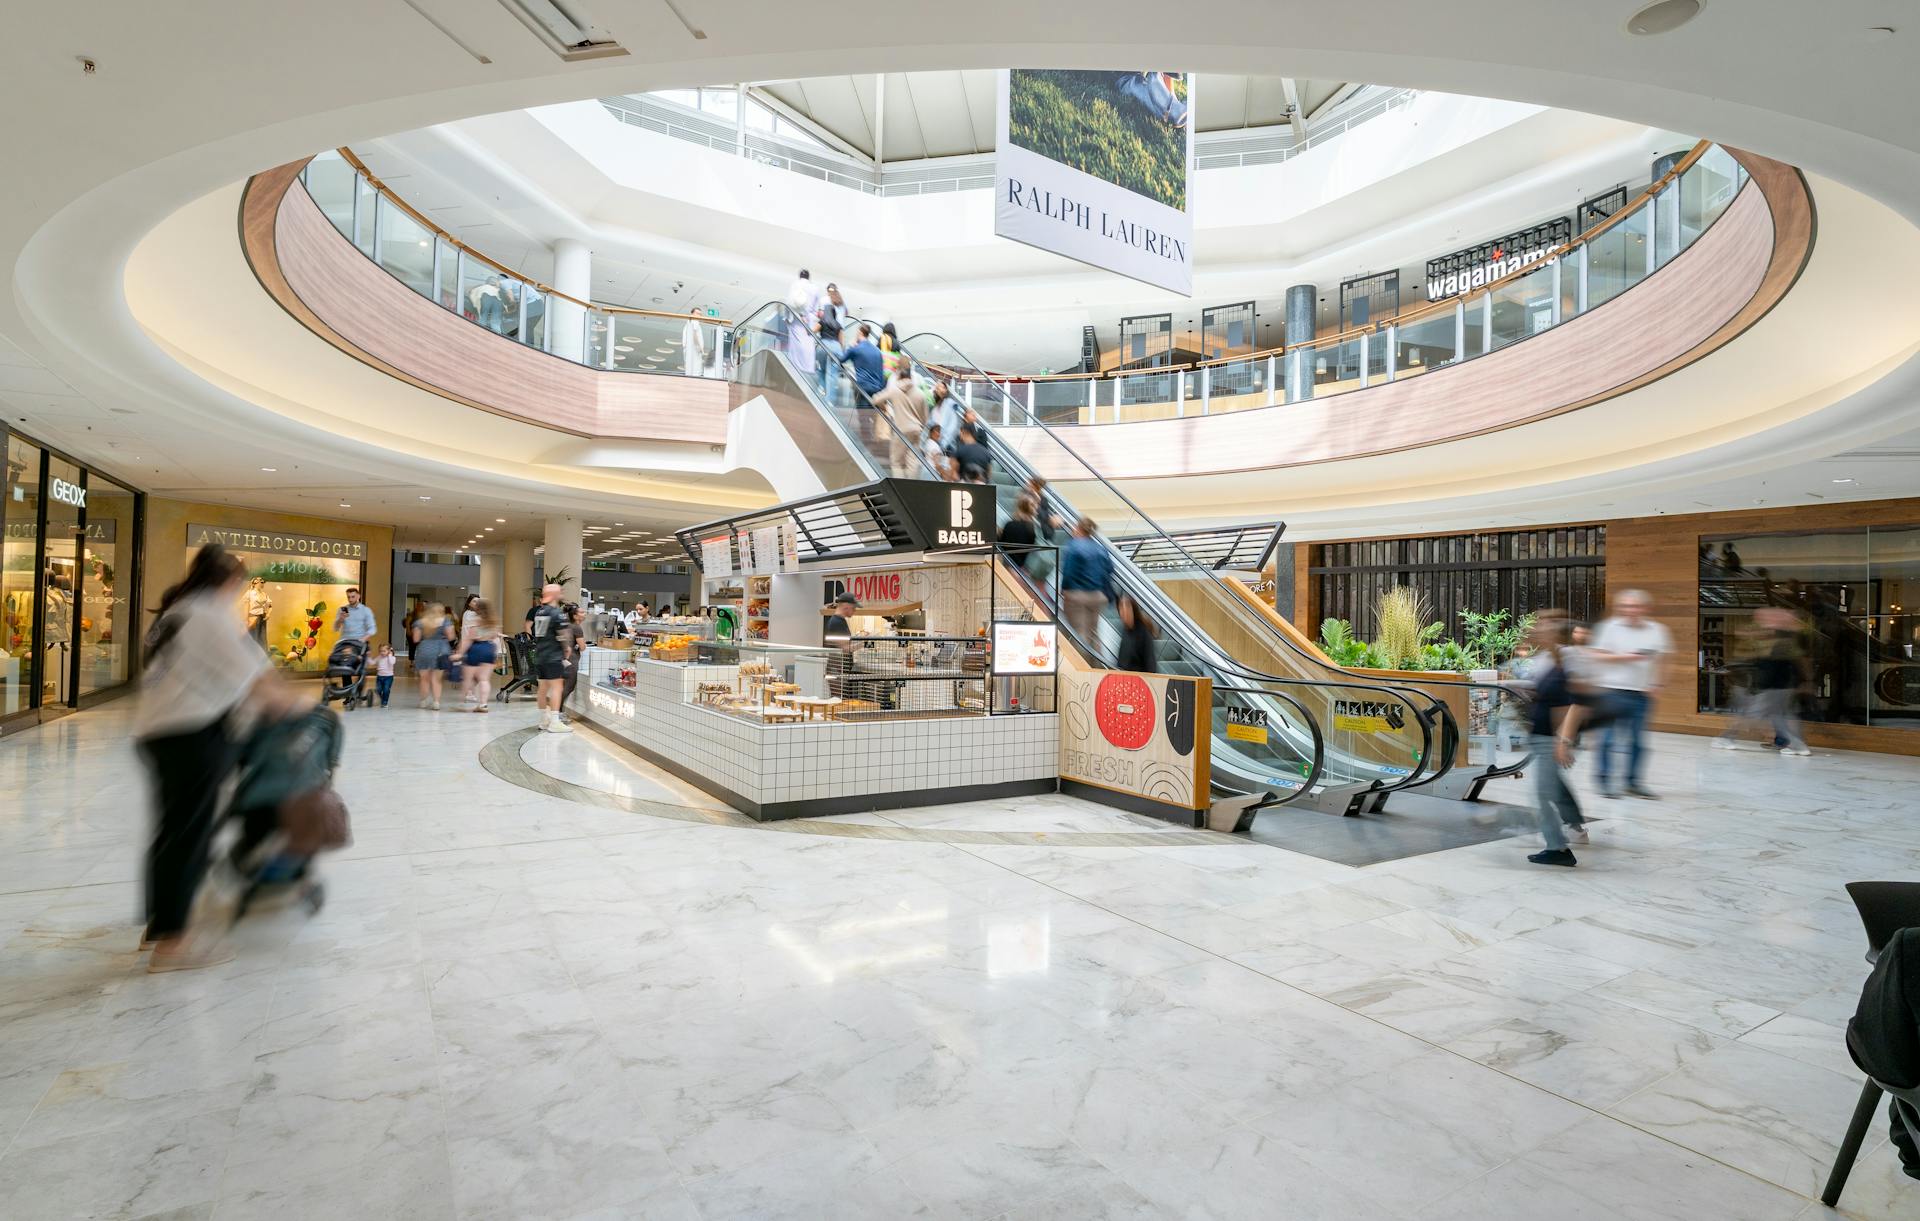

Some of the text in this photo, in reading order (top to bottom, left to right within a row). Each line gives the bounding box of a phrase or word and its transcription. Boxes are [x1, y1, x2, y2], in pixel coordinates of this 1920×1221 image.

[1007, 177, 1186, 264] RALPH LAUREN
[53, 478, 87, 508] GEOX
[950, 490, 973, 528] B
[197, 529, 362, 557] ANTHROPOLOGIE
[938, 529, 986, 545] BAGEL
[84, 596, 127, 605] GEOX
[1063, 748, 1134, 787] FRESH
